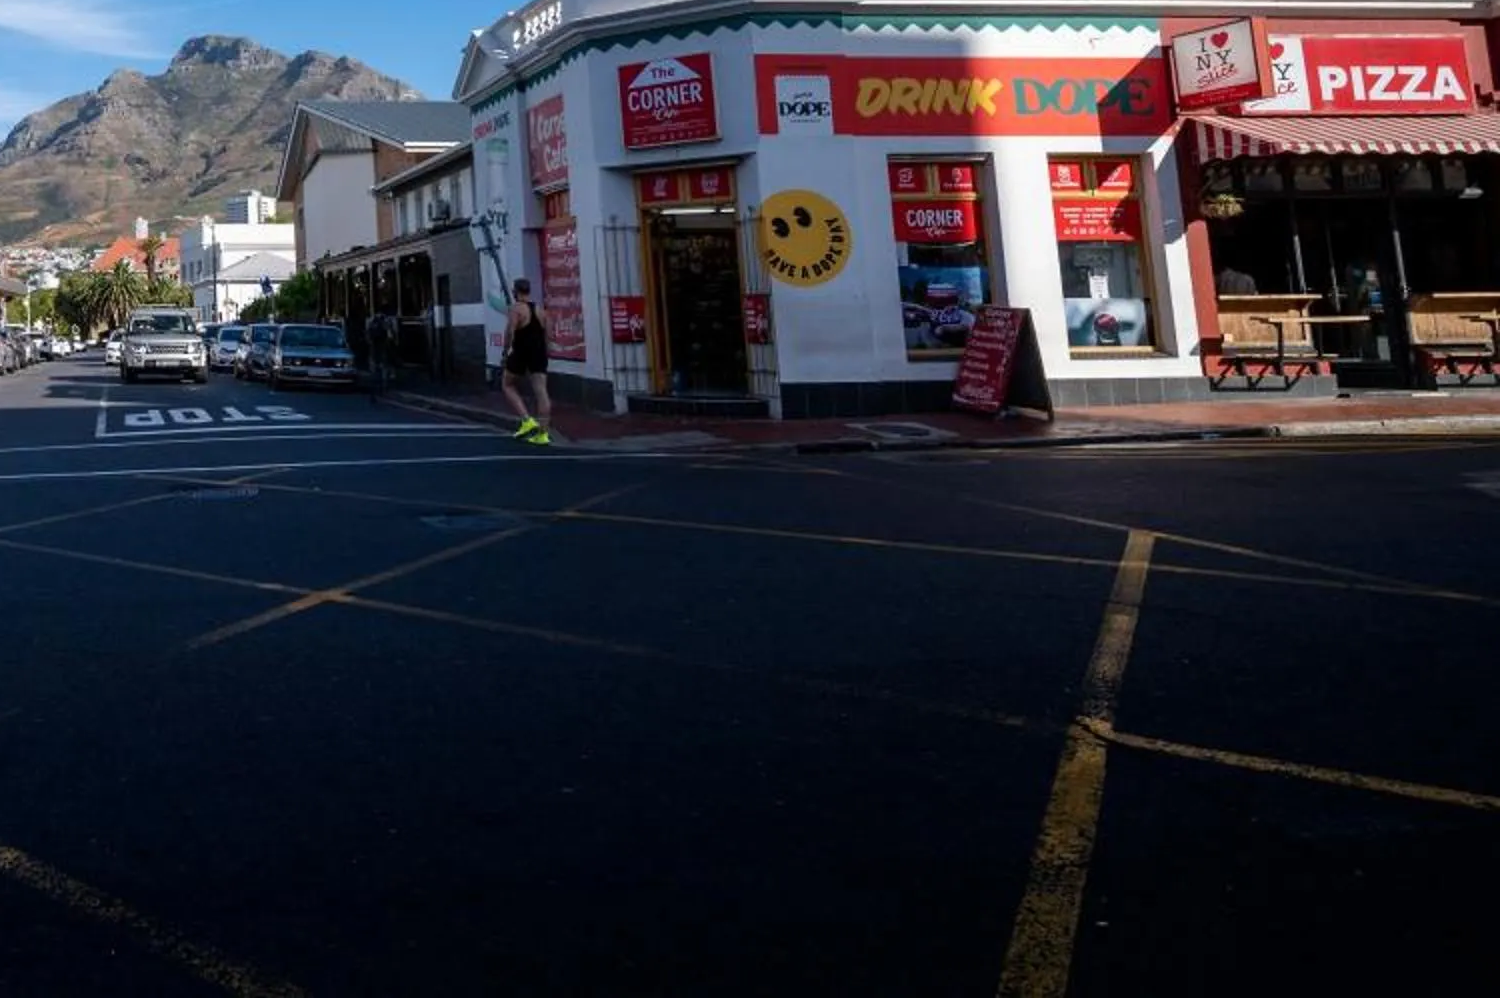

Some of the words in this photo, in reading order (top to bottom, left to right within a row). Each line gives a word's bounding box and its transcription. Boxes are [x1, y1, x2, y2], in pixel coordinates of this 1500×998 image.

[1200, 37, 1207, 53] I
[1195, 49, 1233, 71] NY
[650, 66, 675, 79] The
[1274, 63, 1294, 81] Y
[1318, 65, 1467, 101] PIZZA
[628, 82, 705, 112] CORNER
[855, 78, 1003, 118] DRINK
[1012, 77, 1156, 116] DOPE
[779, 101, 831, 117] DOPE
[906, 208, 964, 228] CORNER
[824, 217, 845, 243] DAY
[763, 248, 797, 278] HAVE
[801, 265, 810, 279] A
[812, 246, 843, 277] DOPE
[123, 405, 311, 427] STOP
